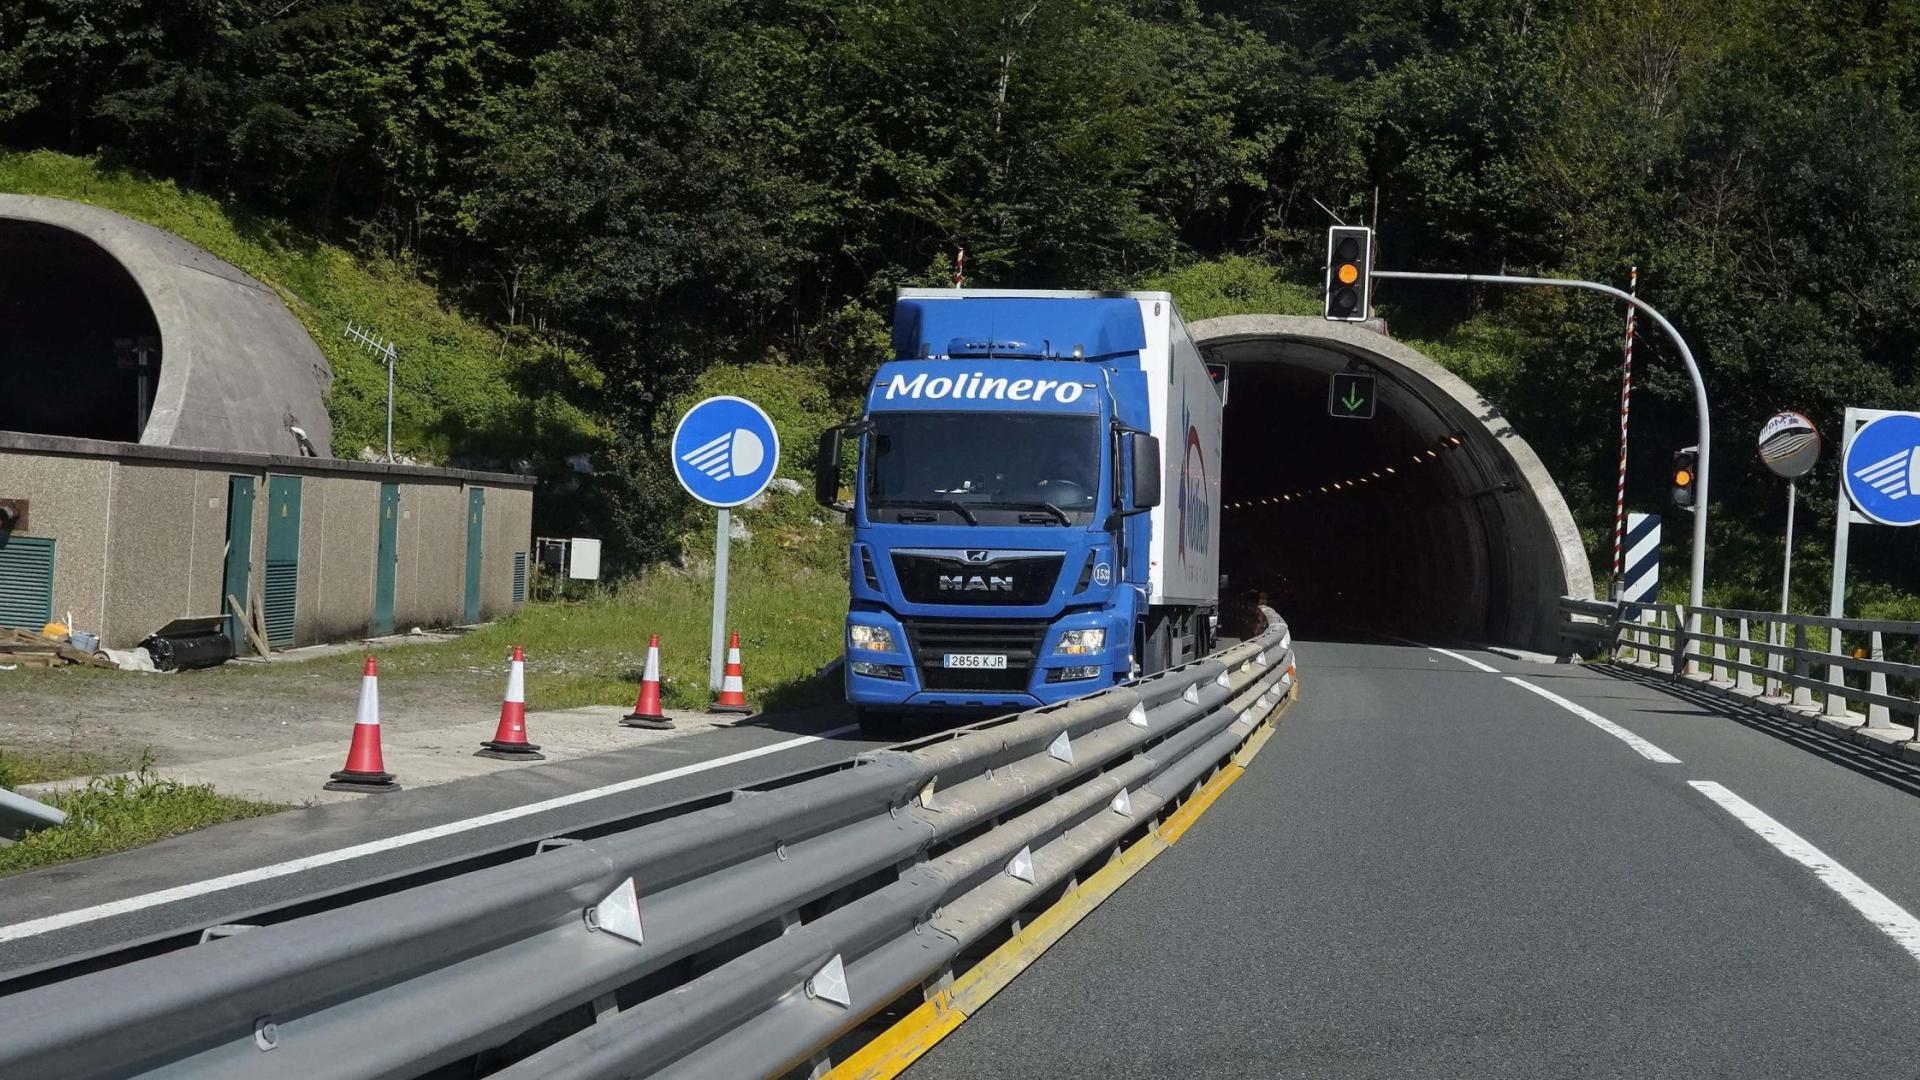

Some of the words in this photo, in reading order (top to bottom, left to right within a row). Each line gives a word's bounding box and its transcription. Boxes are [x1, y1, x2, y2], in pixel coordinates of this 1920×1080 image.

[885, 372, 1083, 403] Molinero
[939, 576, 1013, 591] MAN
[951, 656, 979, 667] 2856
[983, 656, 1004, 667] KJR
